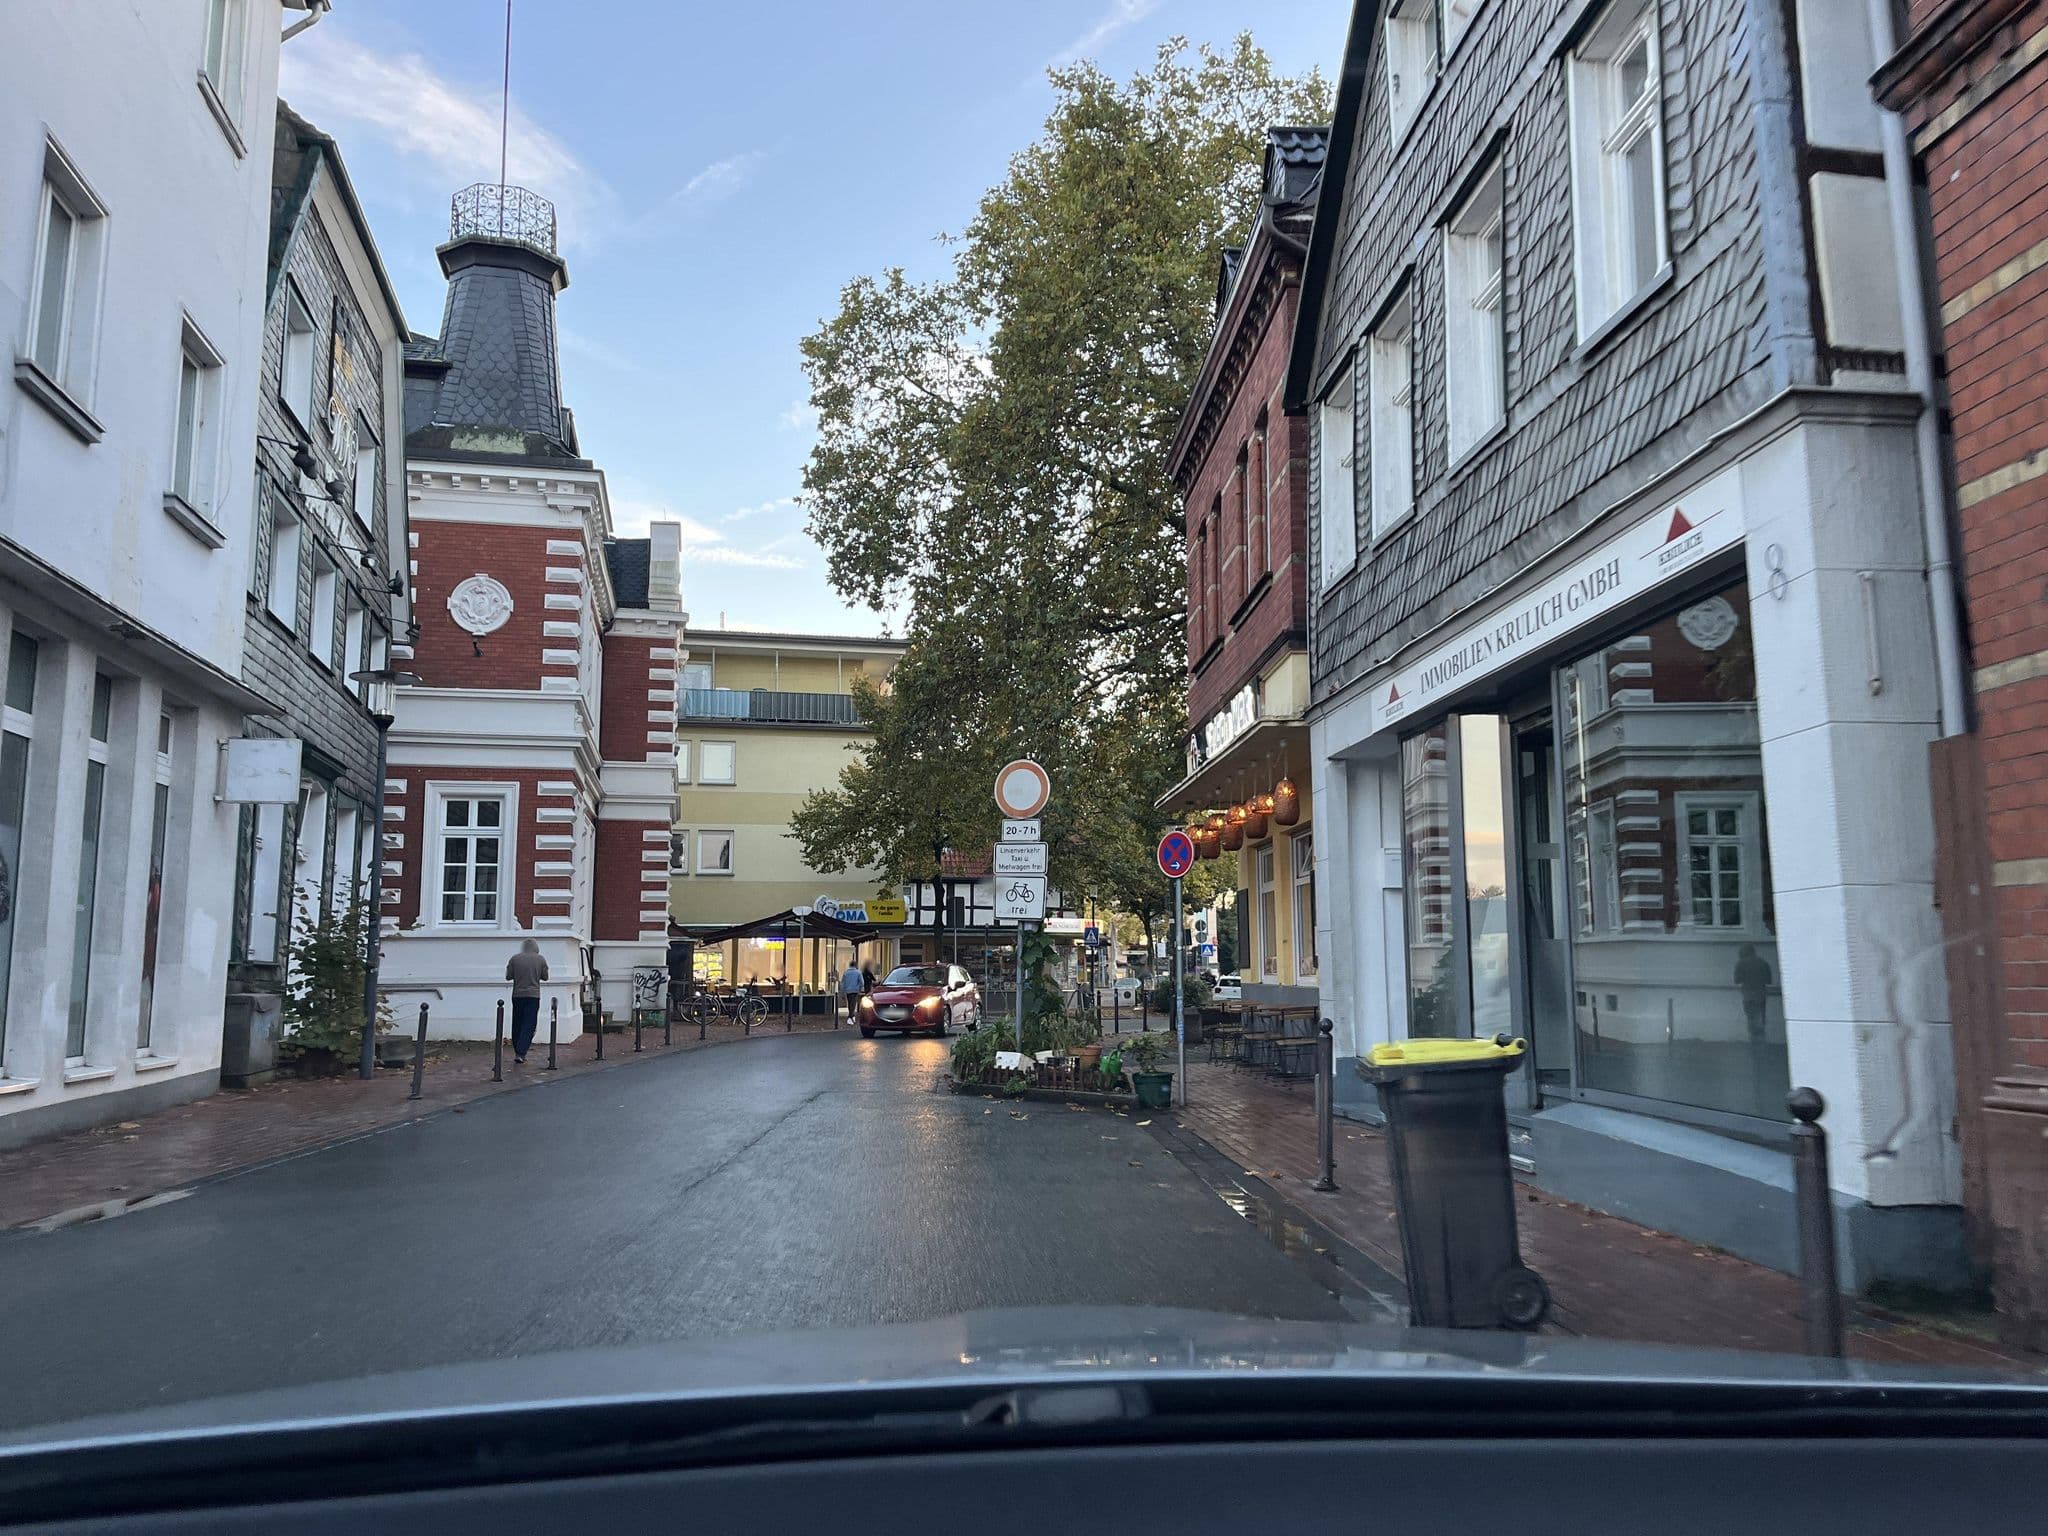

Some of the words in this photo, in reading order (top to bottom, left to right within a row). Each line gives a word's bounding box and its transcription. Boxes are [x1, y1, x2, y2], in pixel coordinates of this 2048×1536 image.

[1419, 633, 1493, 695] IMMOBILIEN
[1495, 591, 1563, 652] KRULICH
[1567, 558, 1621, 612] GMBH
